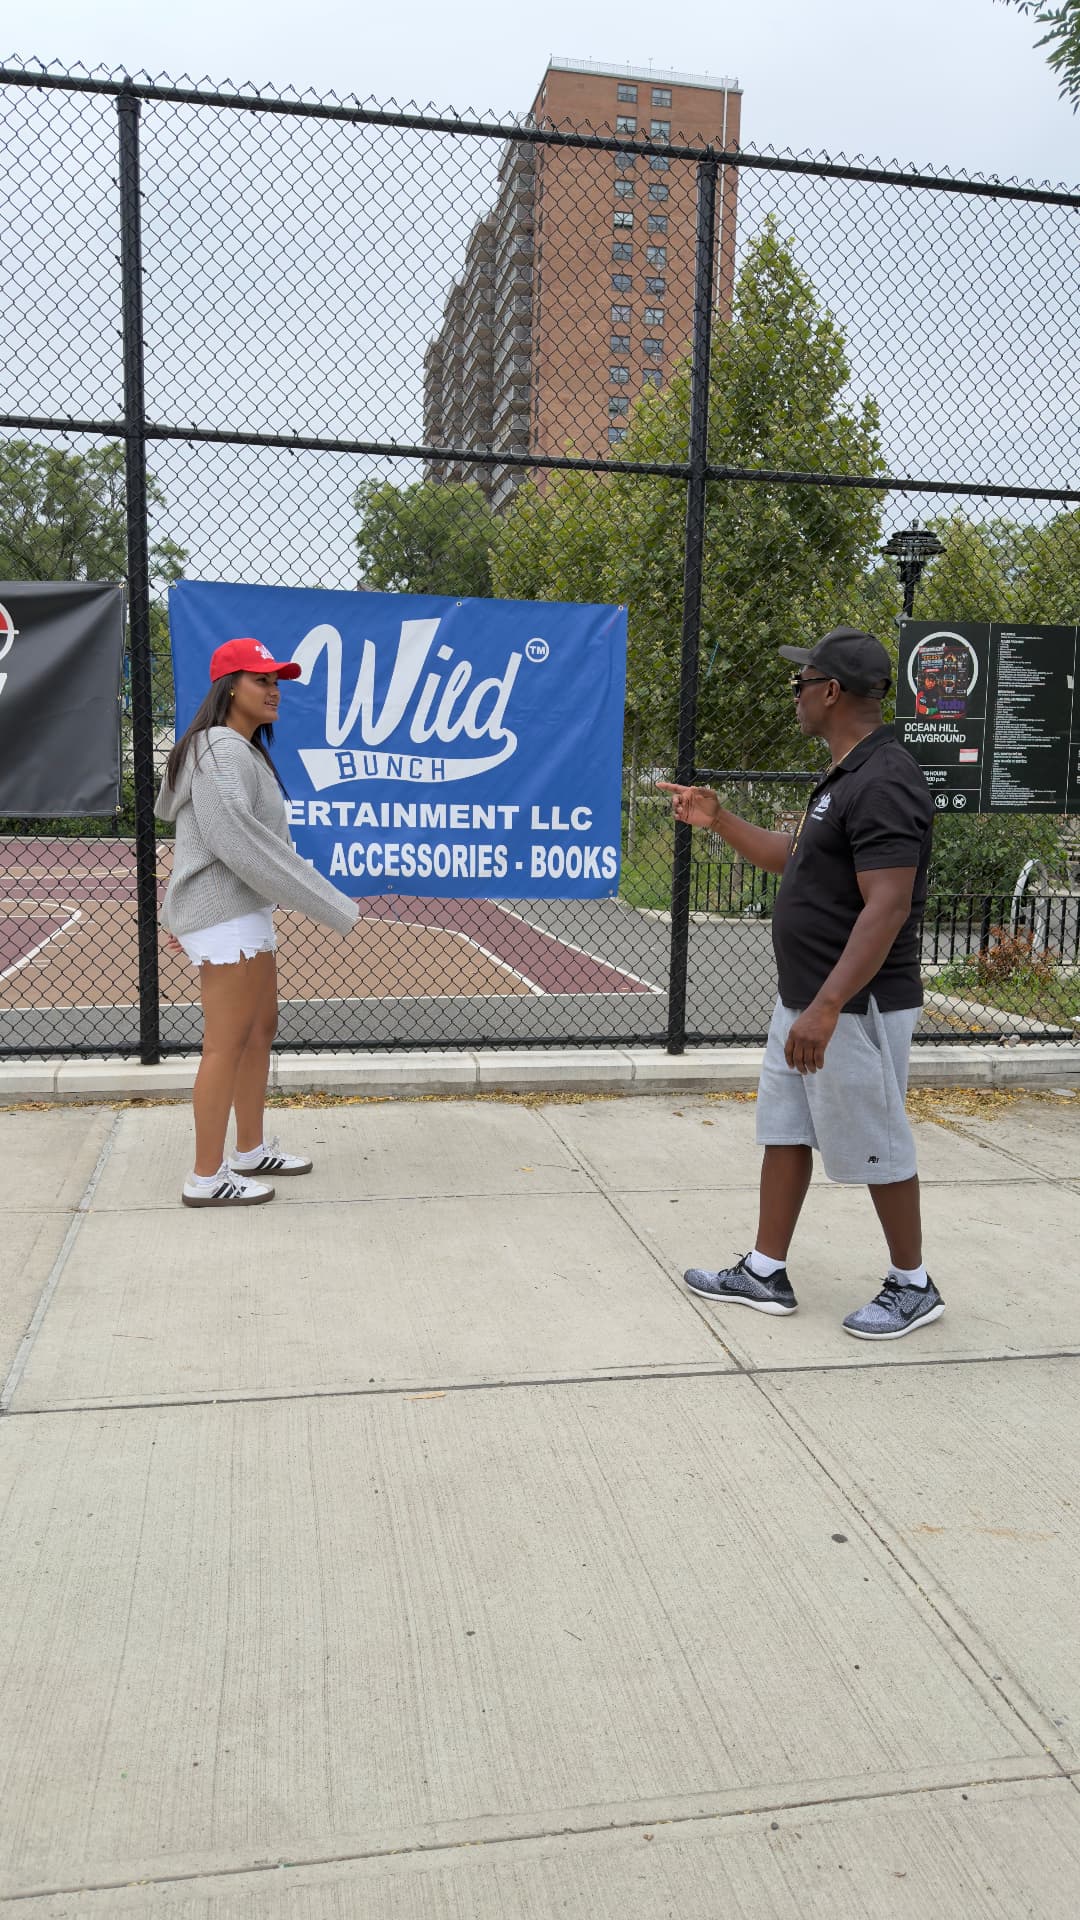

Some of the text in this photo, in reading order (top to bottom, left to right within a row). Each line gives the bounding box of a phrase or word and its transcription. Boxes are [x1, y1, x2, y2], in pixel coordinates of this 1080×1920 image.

[530, 645, 546, 656] TM
[290, 617, 523, 747] Wild
[903, 733, 967, 744] PLAYGROUND
[904, 722, 960, 733] OCEAN HILL
[335, 751, 446, 781] BUNCH
[531, 805, 593, 831] LLC
[329, 842, 508, 878] ACCESSORIES
[531, 845, 617, 879] BOOKS
